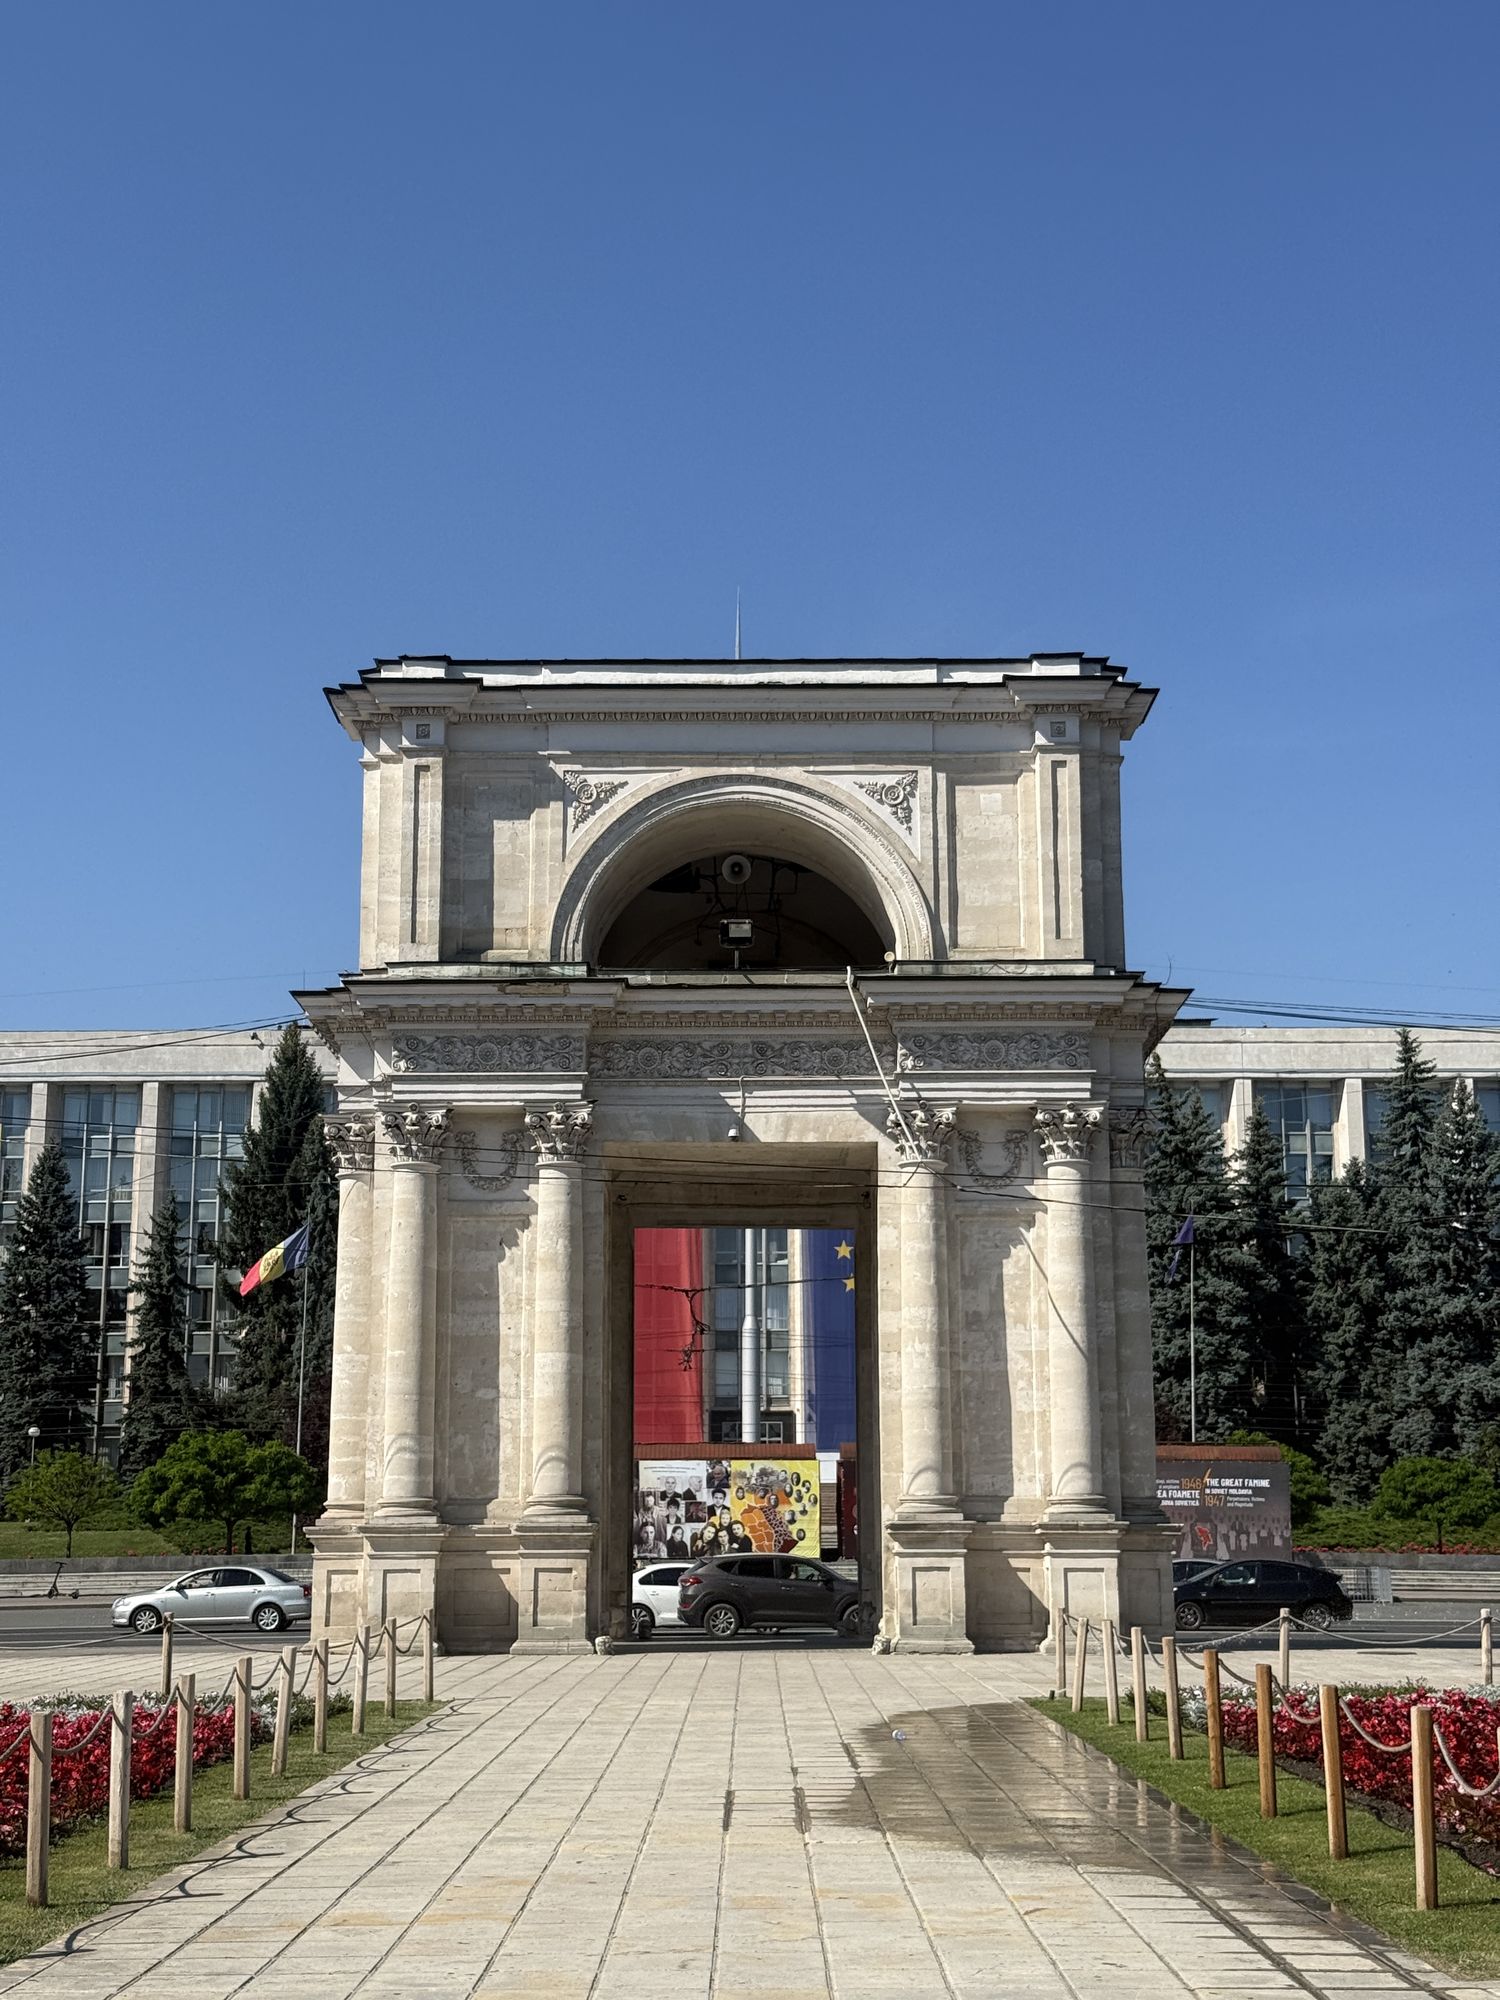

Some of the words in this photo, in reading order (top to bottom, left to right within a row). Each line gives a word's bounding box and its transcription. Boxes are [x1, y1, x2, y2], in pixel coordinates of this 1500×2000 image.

[1181, 1478, 1202, 1490] 1946
[1206, 1479, 1219, 1487] THE
[1221, 1479, 1243, 1487] GREAT
[1245, 1479, 1270, 1488] FAMINE
[1169, 1490, 1201, 1499] FOAMETE
[1205, 1495, 1225, 1507] 1947
